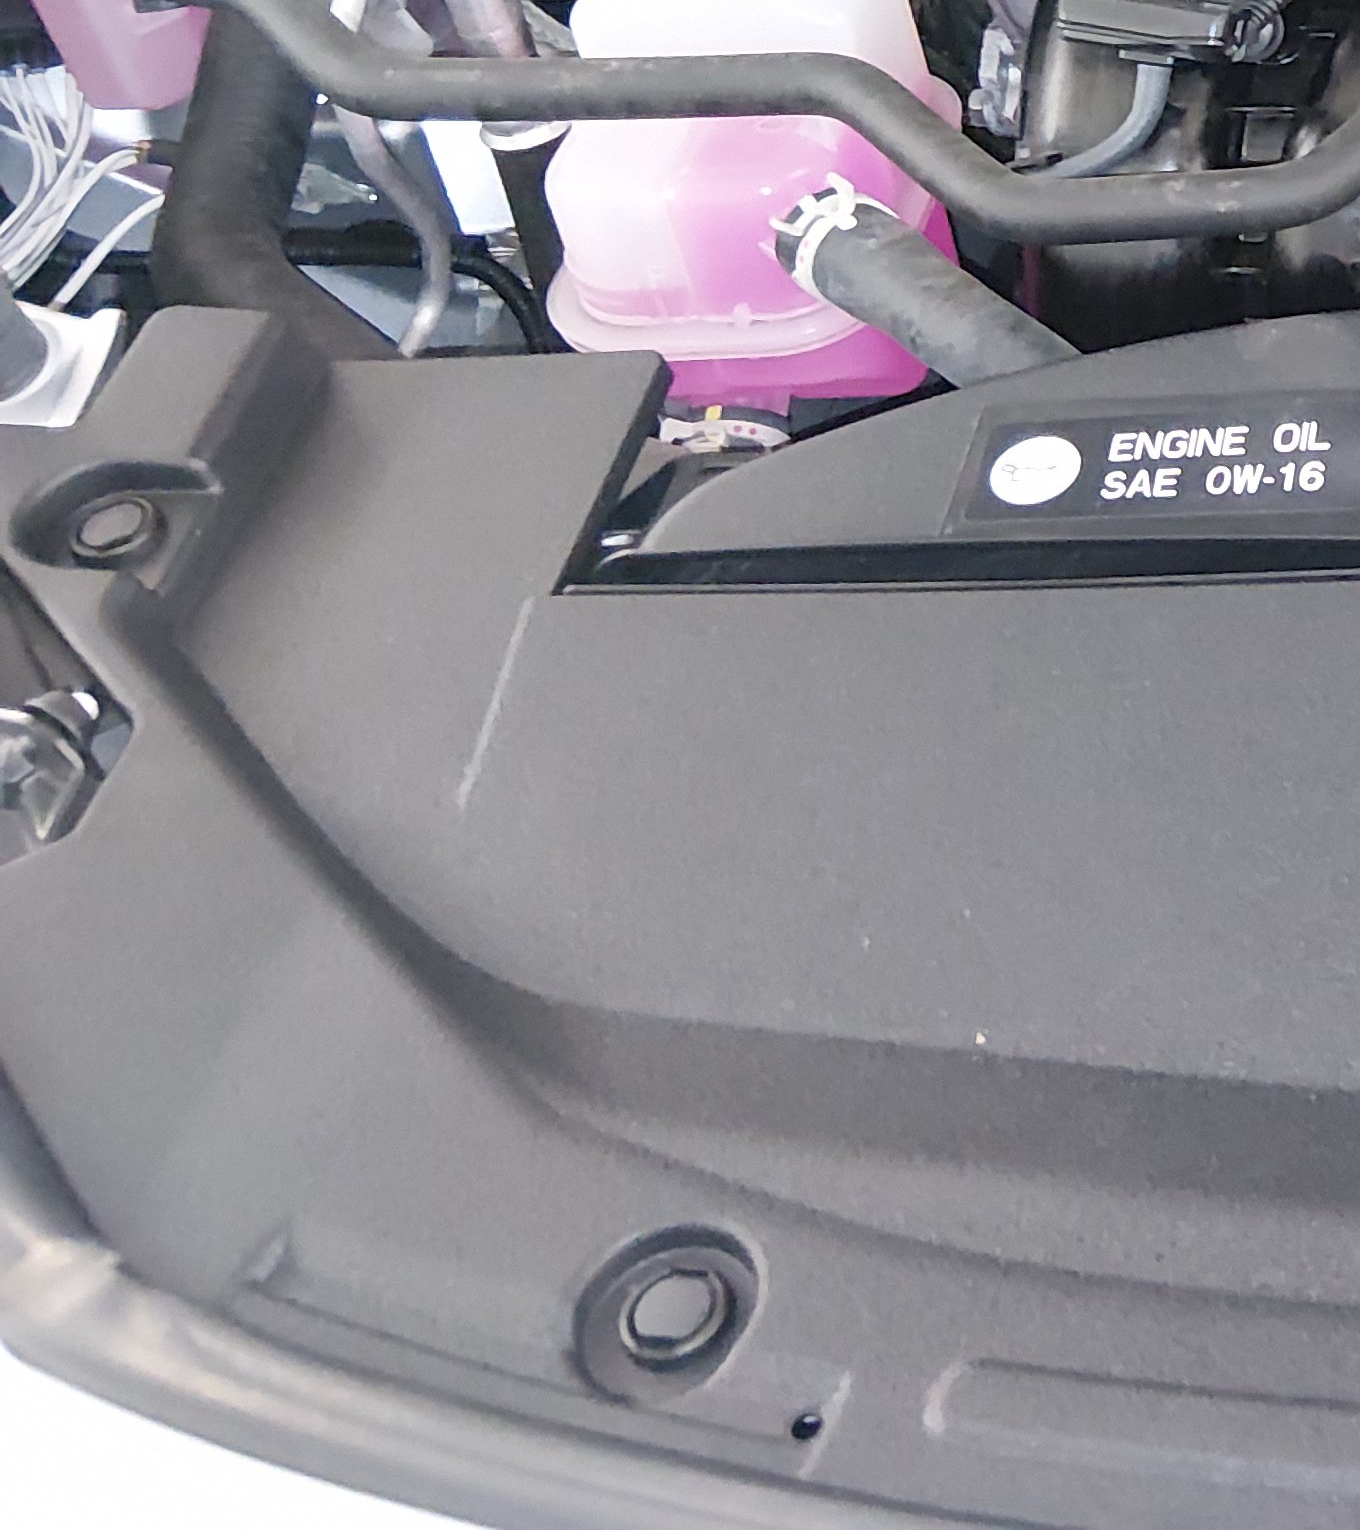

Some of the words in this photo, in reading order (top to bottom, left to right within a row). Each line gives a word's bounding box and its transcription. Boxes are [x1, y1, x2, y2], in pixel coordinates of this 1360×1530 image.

[1107, 425, 1251, 464] ENGINE
[1272, 421, 1332, 452] OIL
[1099, 468, 1182, 500] SAE
[1204, 461, 1327, 497] 0W-16
